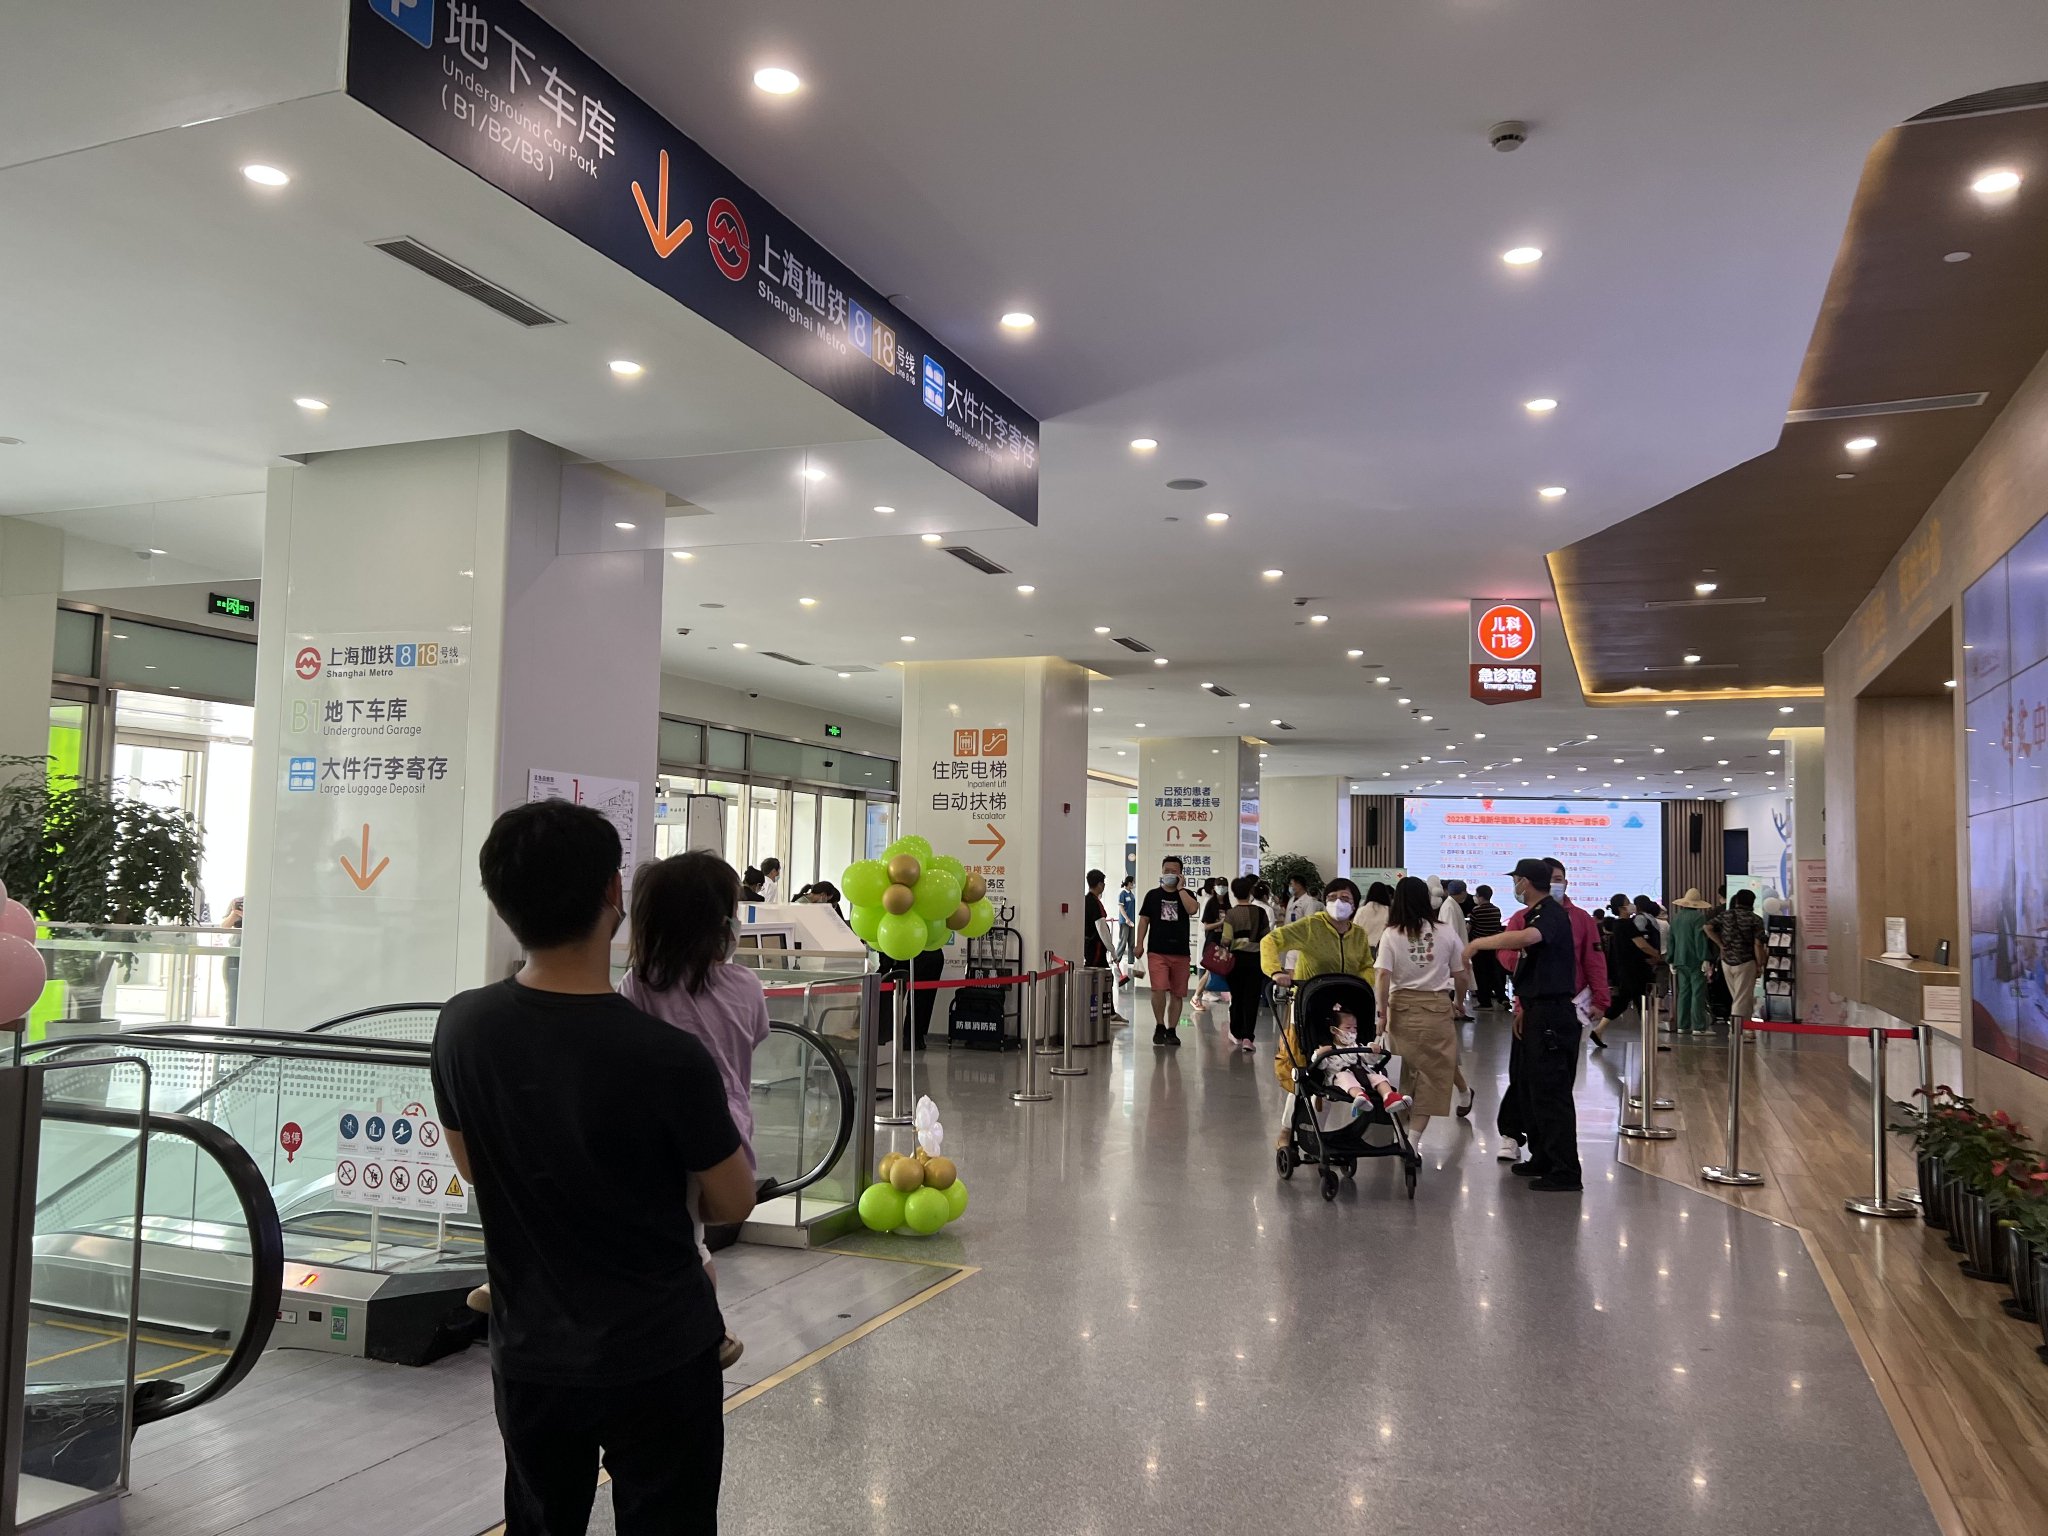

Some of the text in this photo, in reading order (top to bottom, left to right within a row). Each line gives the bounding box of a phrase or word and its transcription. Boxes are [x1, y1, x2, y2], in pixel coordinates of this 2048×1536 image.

[444, 0, 616, 159] 地下车库
[442, 54, 598, 179] Underground Car Park
[758, 233, 847, 331] 上海地铁
[873, 325, 894, 367] 18
[896, 344, 916, 375] 号线
[758, 280, 847, 355] Shanghai Metro
[946, 379, 1036, 469] 大件行李寄存
[946, 415, 962, 436] Large
[961, 428, 985, 452] Luggage
[1490, 615, 1522, 632] 儿科
[1491, 633, 1522, 648] 门诊
[326, 644, 459, 667] 上海地铁 8 18 号线
[326, 668, 394, 679] Shanghai Metro
[1478, 667, 1537, 683] 急诊预检
[291, 698, 322, 734] B1
[324, 697, 408, 723] 地下车库
[323, 724, 422, 737] Underground Garage
[321, 756, 448, 781] 大件行李寄存
[932, 760, 1007, 779] 住院电梯
[320, 782, 426, 796] Large Luggage Deposit
[967, 780, 997, 788] Inpatient
[1164, 786, 1211, 796] 已预约患者
[932, 792, 1007, 811] 自动扶梯
[1155, 797, 1220, 807] 请直接二楼挂号
[972, 812, 1007, 820] Escalator
[281, 1130, 301, 1144] 急停
